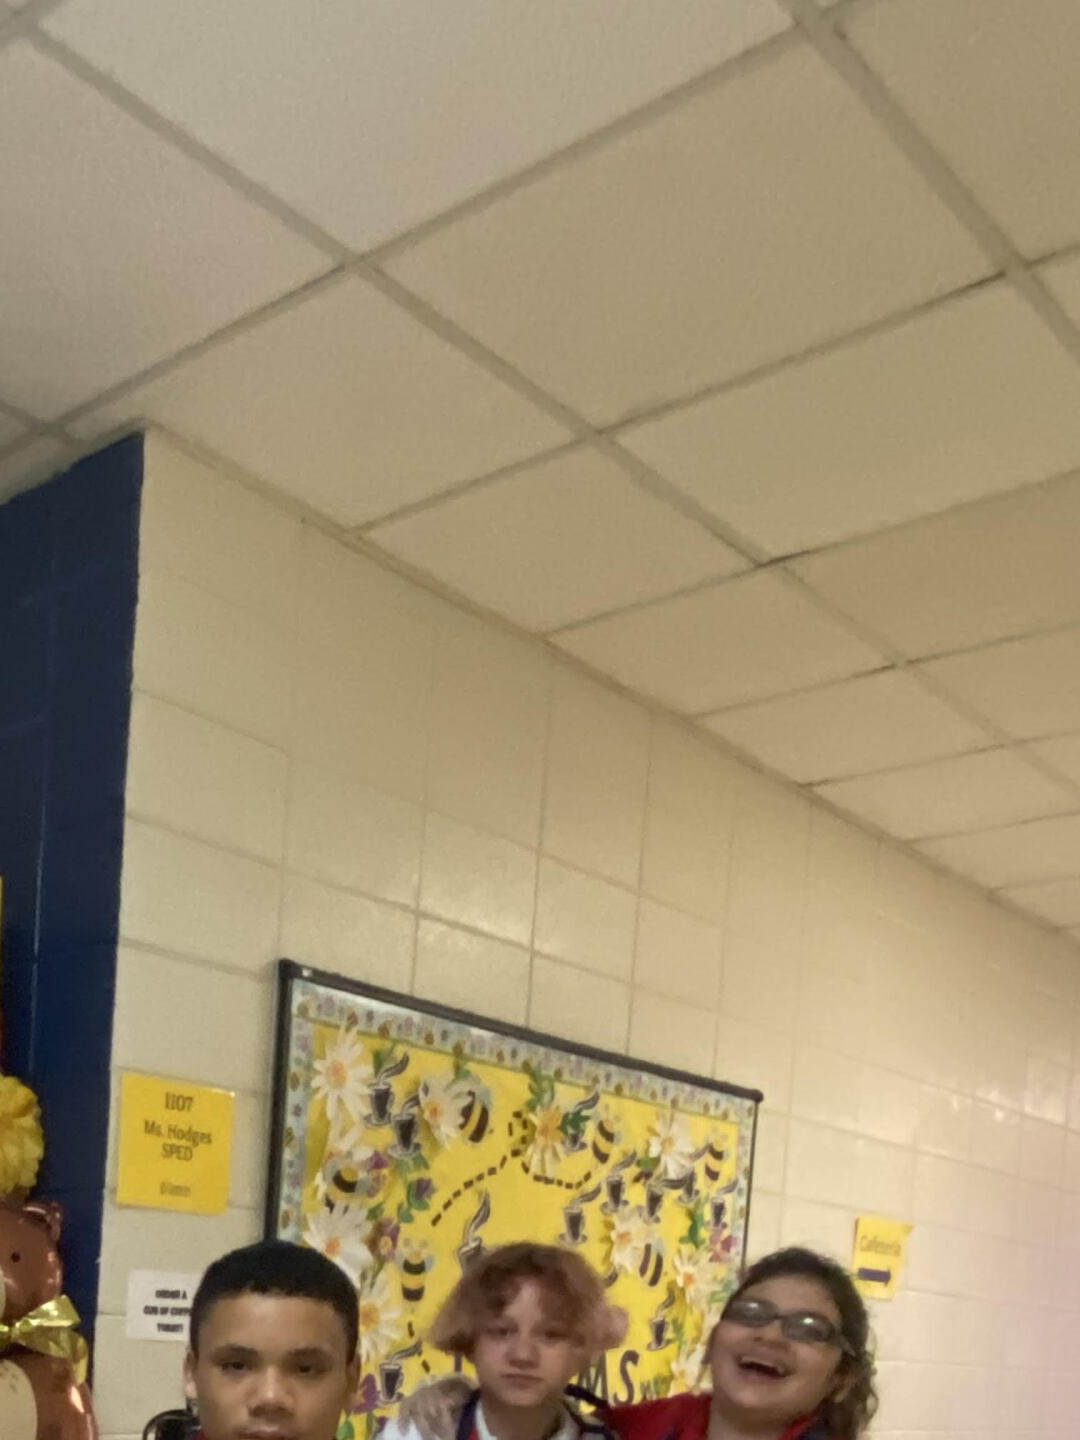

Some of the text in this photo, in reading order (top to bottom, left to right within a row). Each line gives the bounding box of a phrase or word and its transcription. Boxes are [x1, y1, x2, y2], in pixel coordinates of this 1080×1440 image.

[164, 1092, 194, 1112] 1107
[167, 1124, 212, 1148] Hodges
[161, 1142, 194, 1161] SPED
